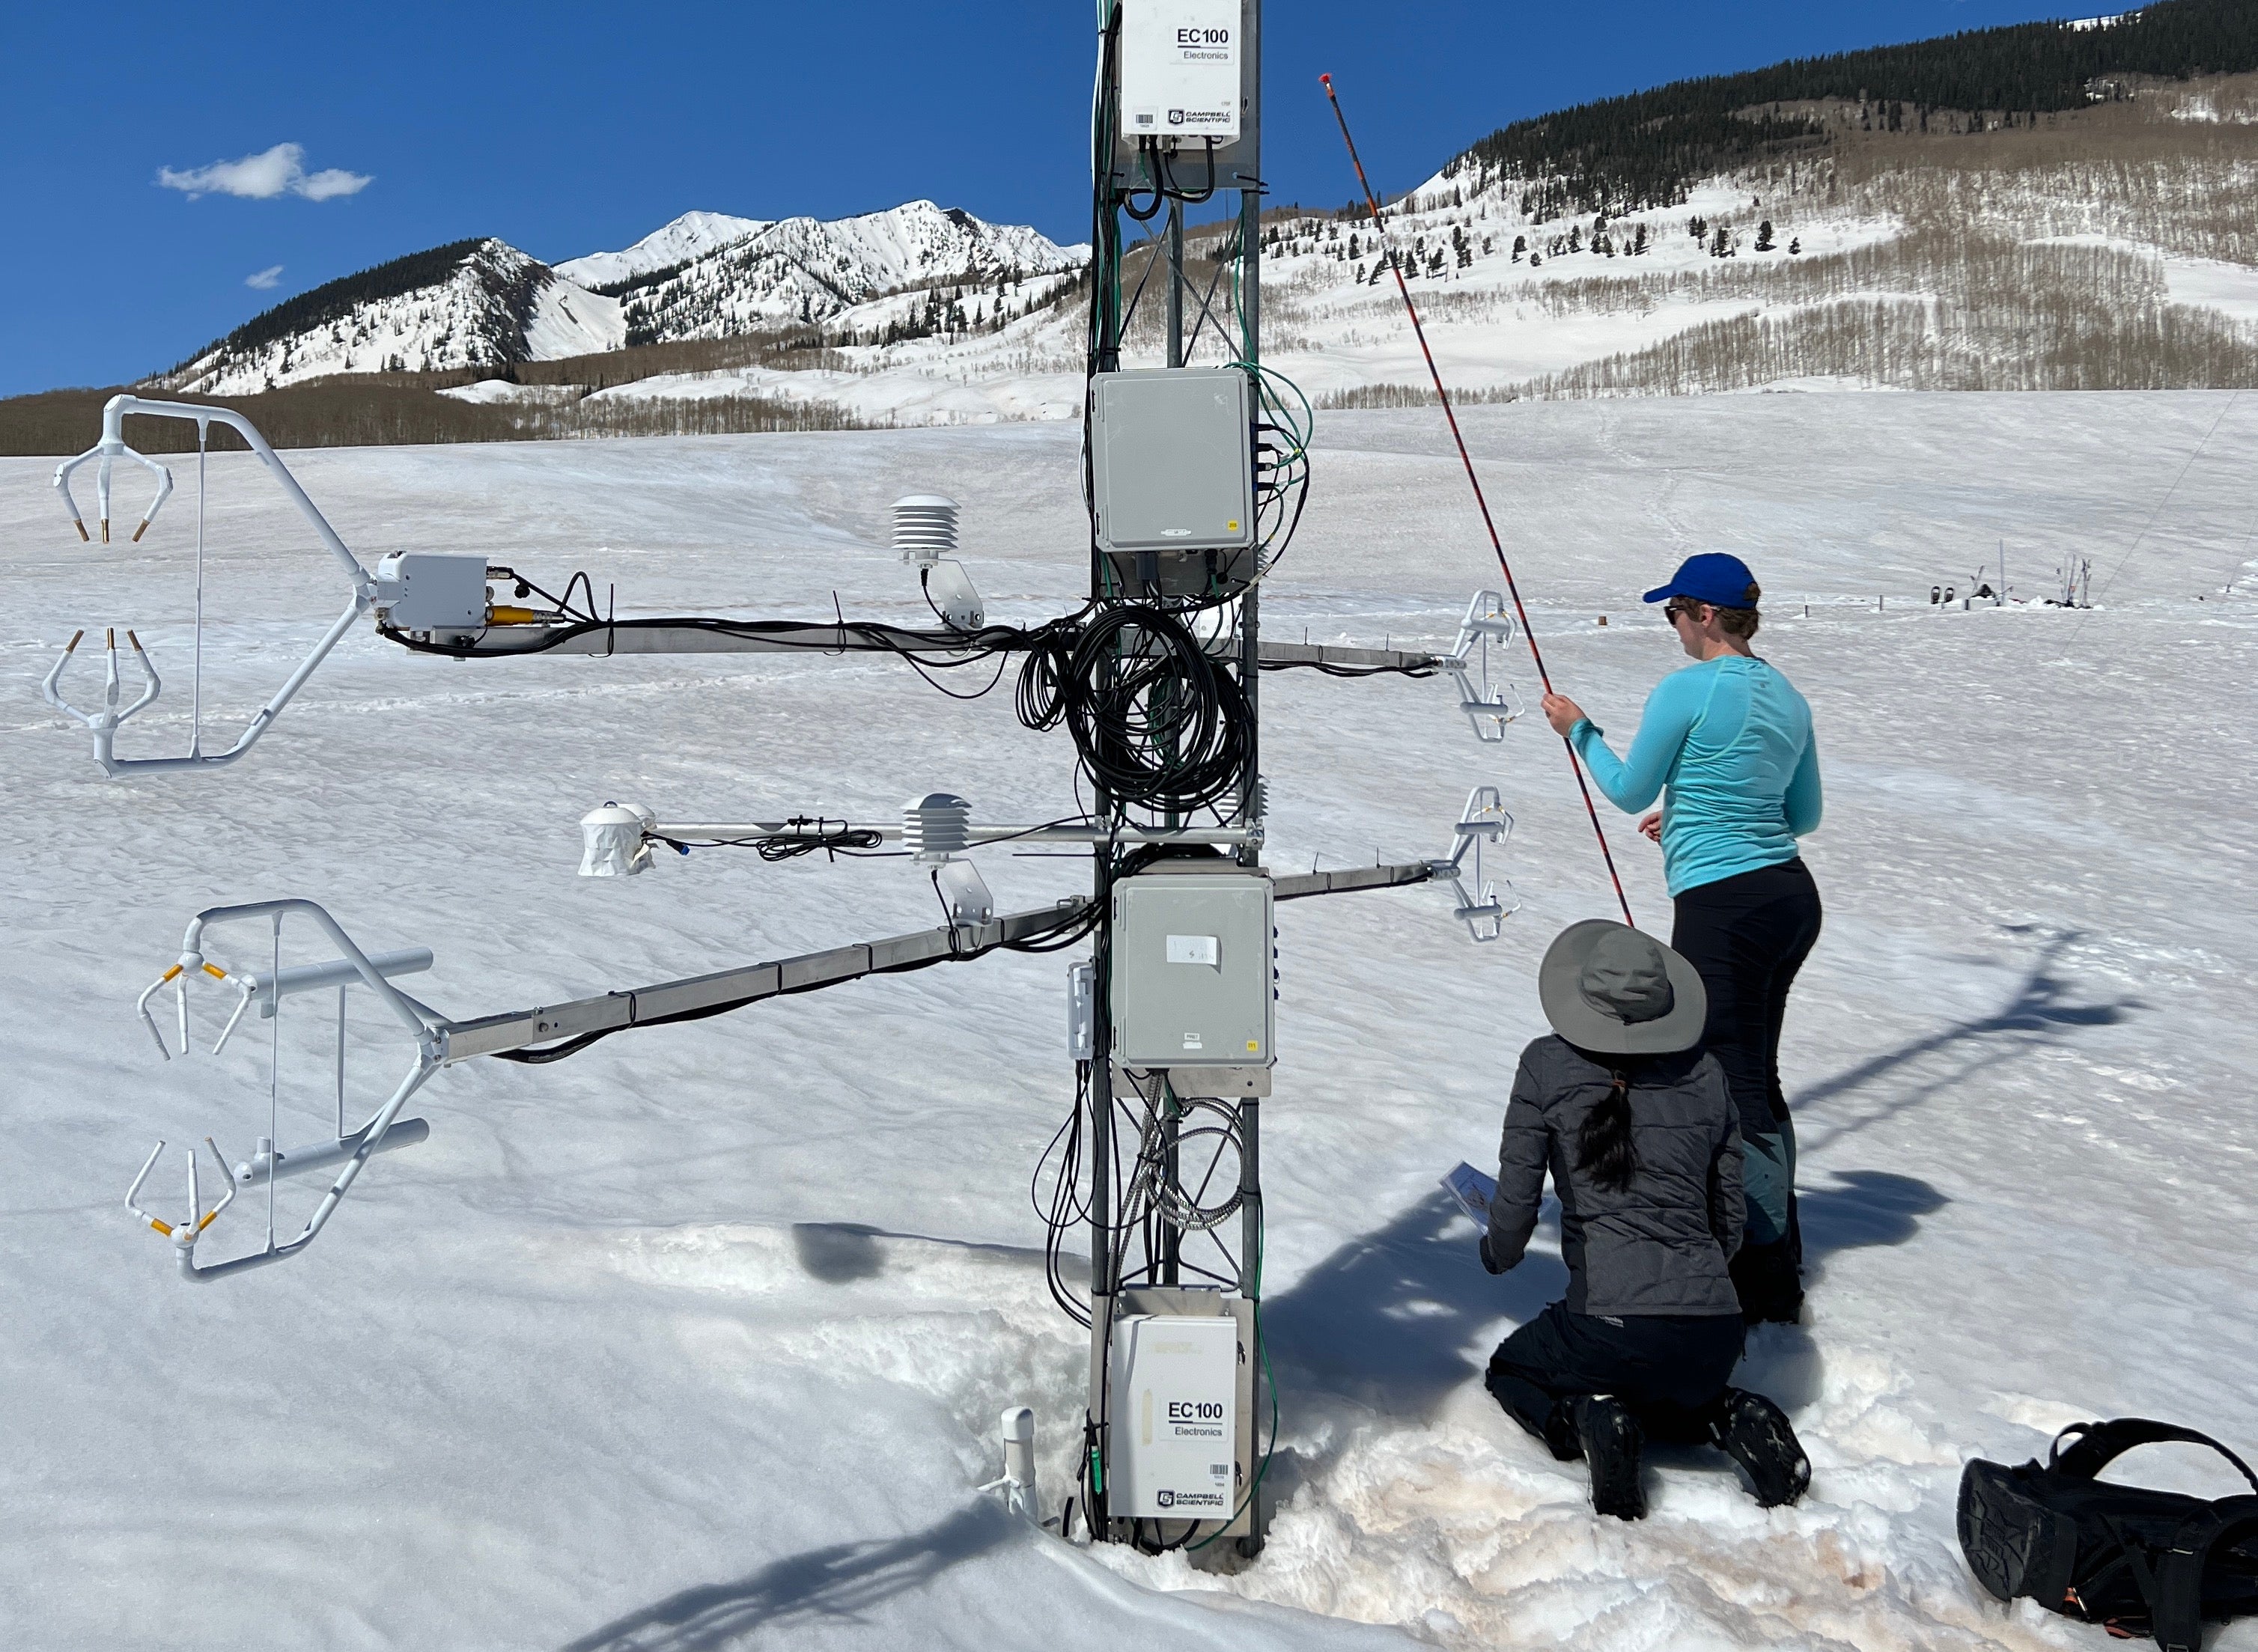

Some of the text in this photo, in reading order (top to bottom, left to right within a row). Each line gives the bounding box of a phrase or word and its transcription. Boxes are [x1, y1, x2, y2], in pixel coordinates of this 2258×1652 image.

[1178, 28, 1229, 43] EC100
[1184, 51, 1228, 59] Electronics
[1169, 1402, 1223, 1418] EC100
[1175, 1426, 1223, 1436] Electronics
